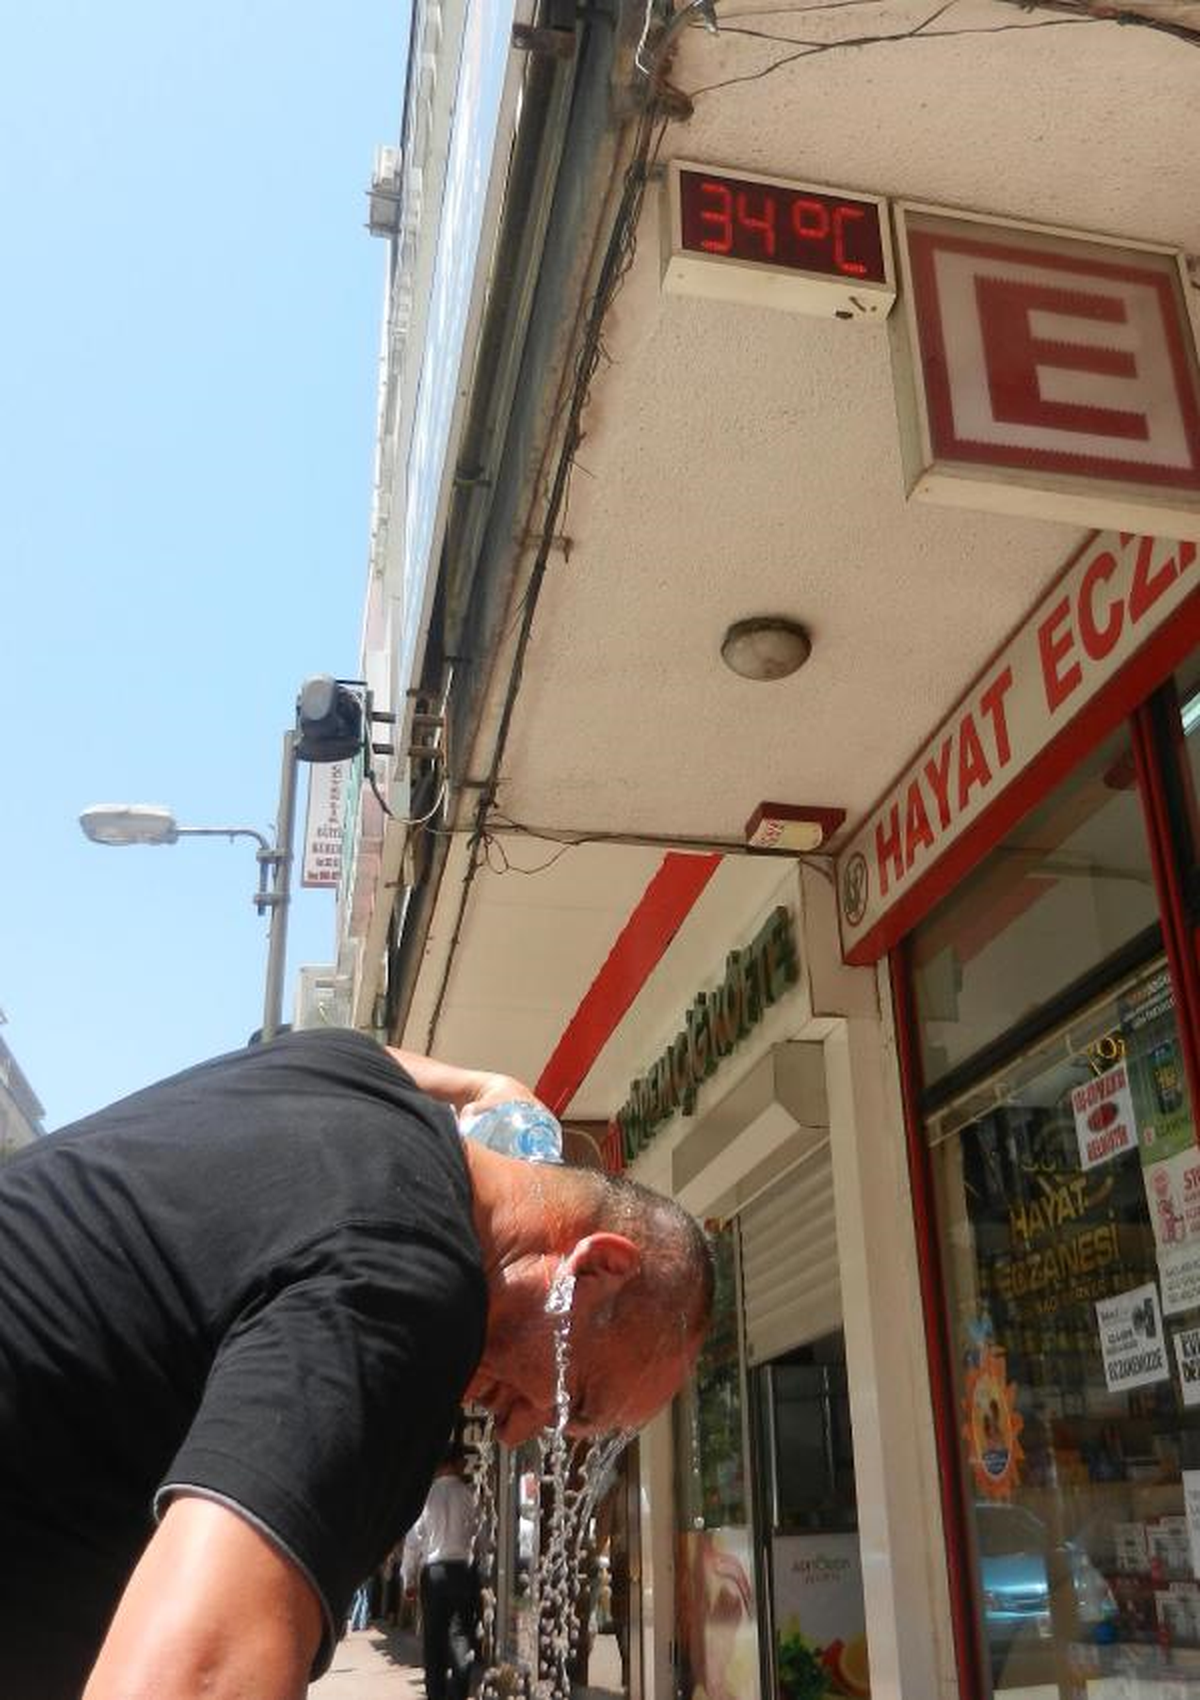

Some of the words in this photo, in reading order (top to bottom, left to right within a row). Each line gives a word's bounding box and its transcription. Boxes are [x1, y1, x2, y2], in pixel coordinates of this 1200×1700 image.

[700, 181, 775, 257] 34
[973, 272, 1151, 442] E
[873, 665, 1015, 897] HAYAT
[1009, 1178, 1087, 1246] HAYAT
